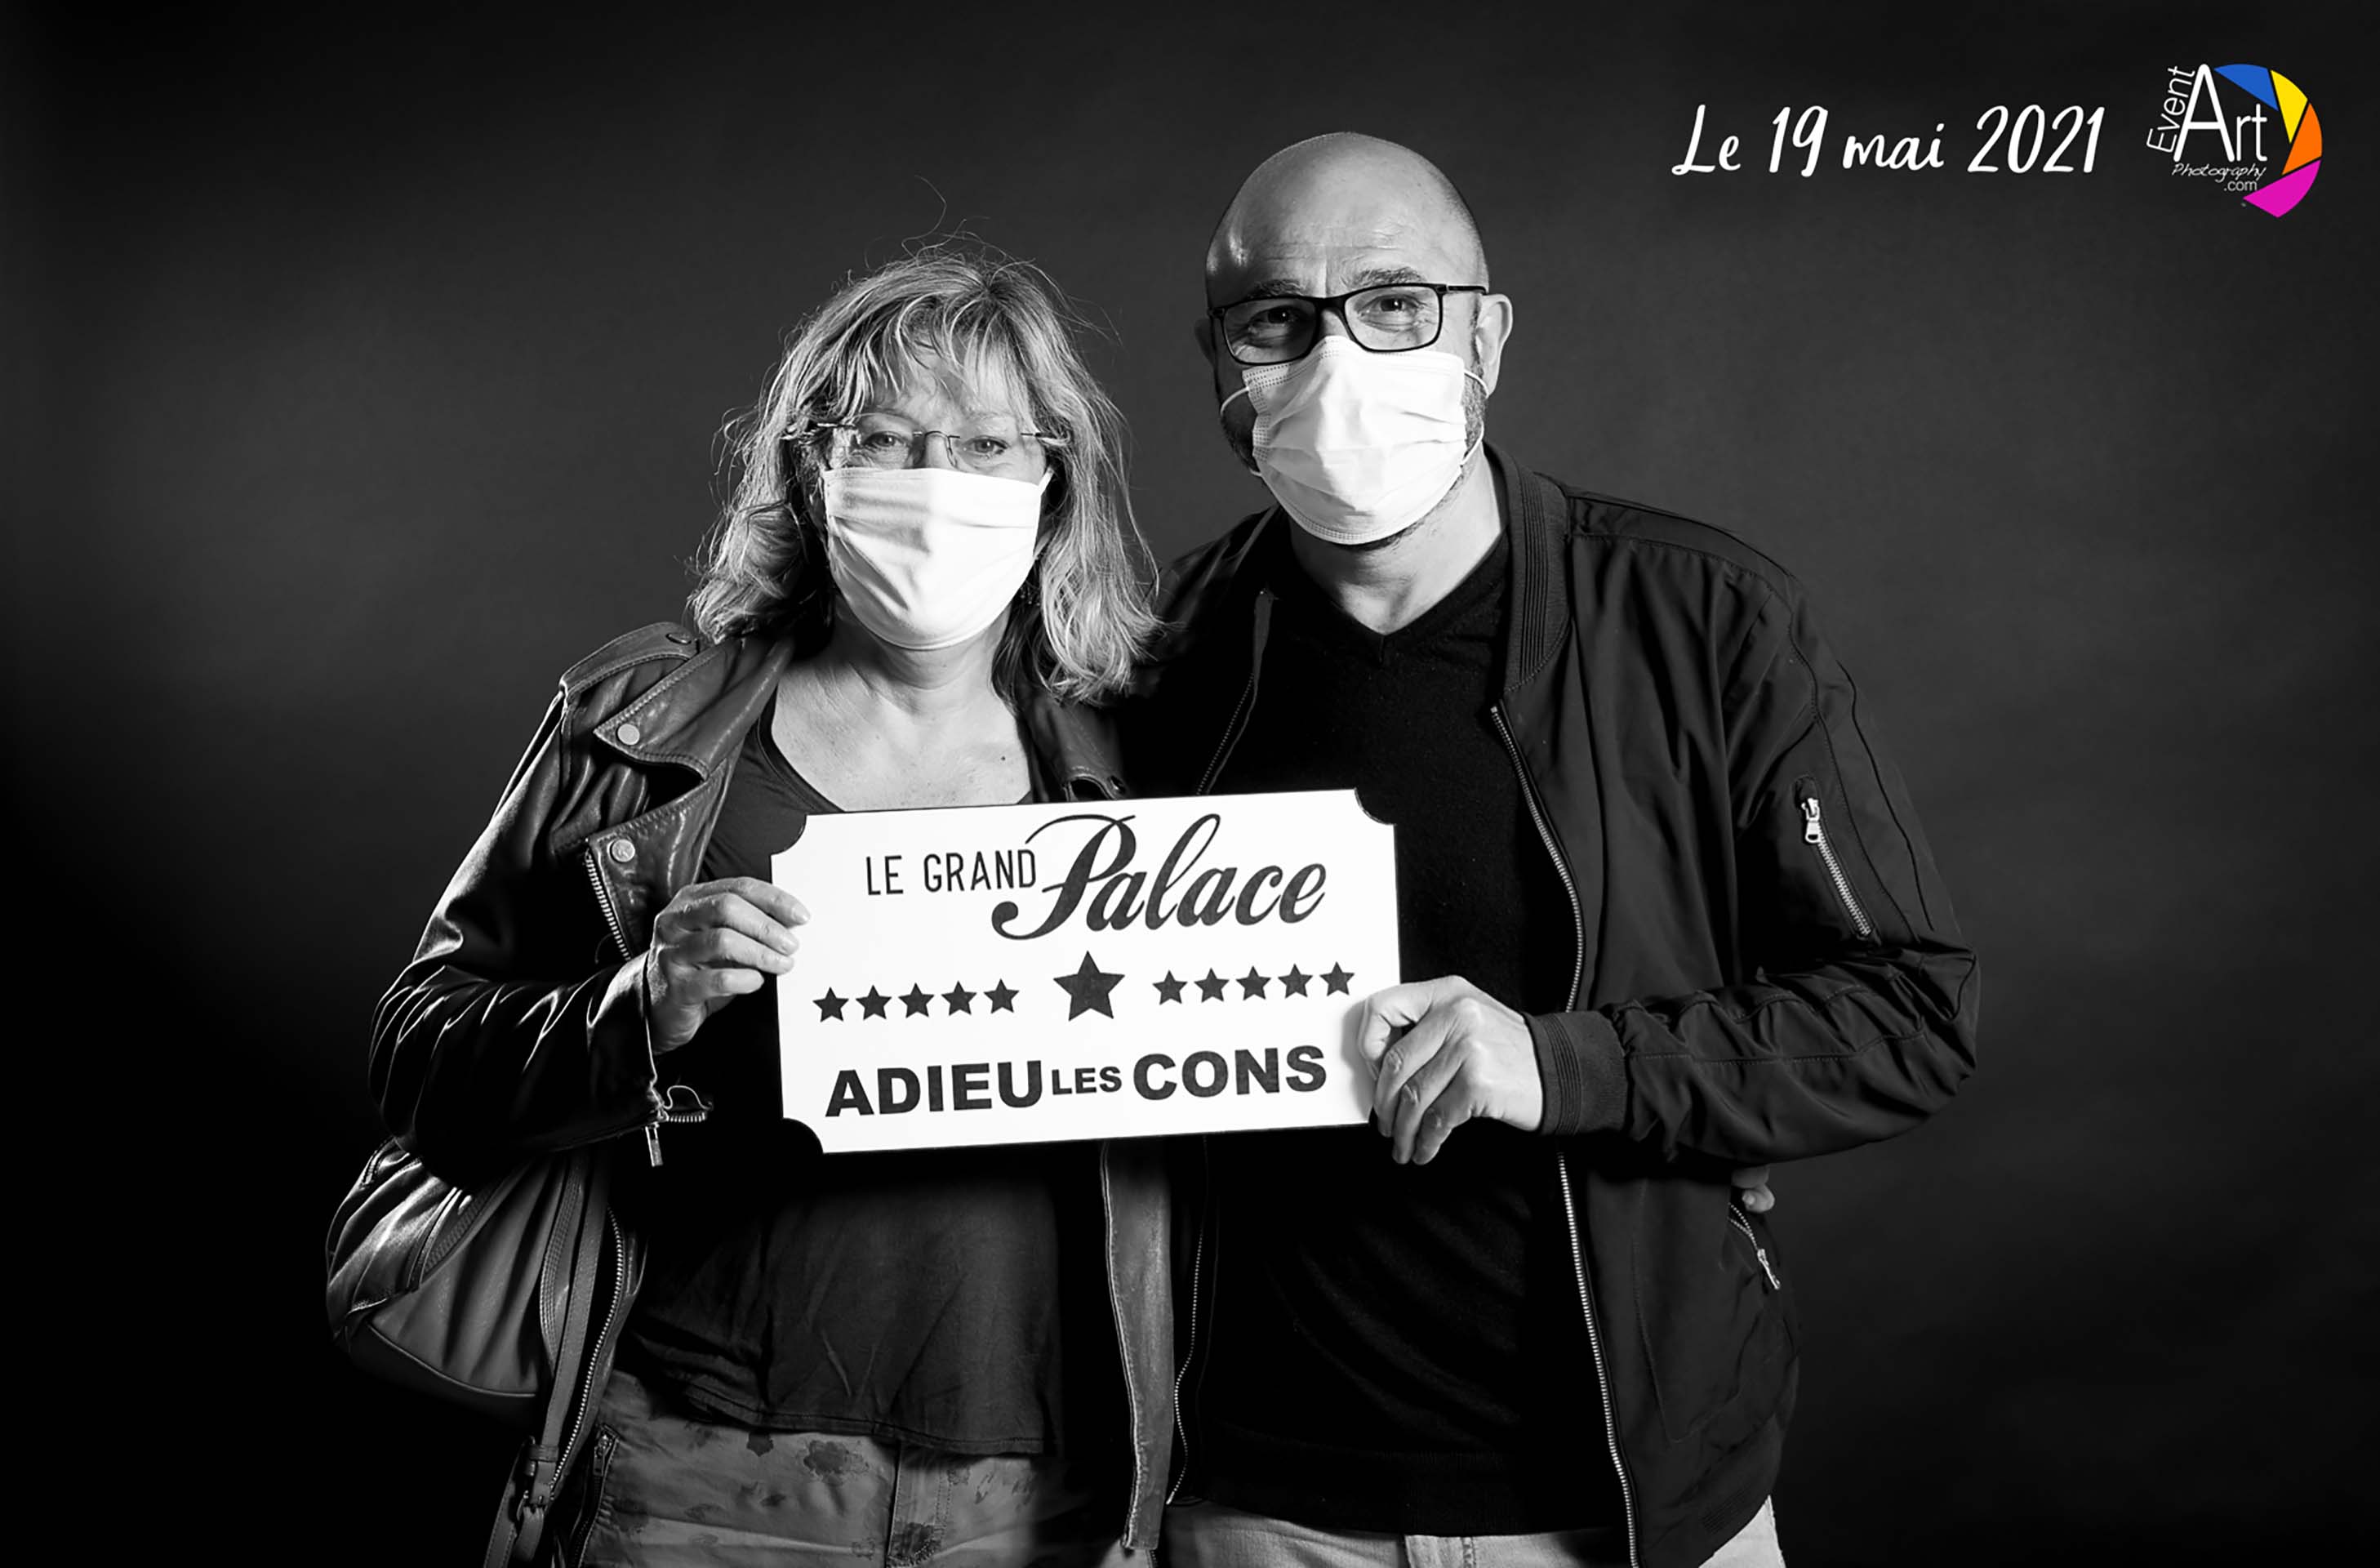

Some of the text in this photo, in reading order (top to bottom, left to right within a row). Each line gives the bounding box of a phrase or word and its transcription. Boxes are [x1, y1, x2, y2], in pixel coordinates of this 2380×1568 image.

[865, 813, 1327, 941] LE GRAND Palace
[825, 1045, 1327, 1118] ADIEU LES CONS
